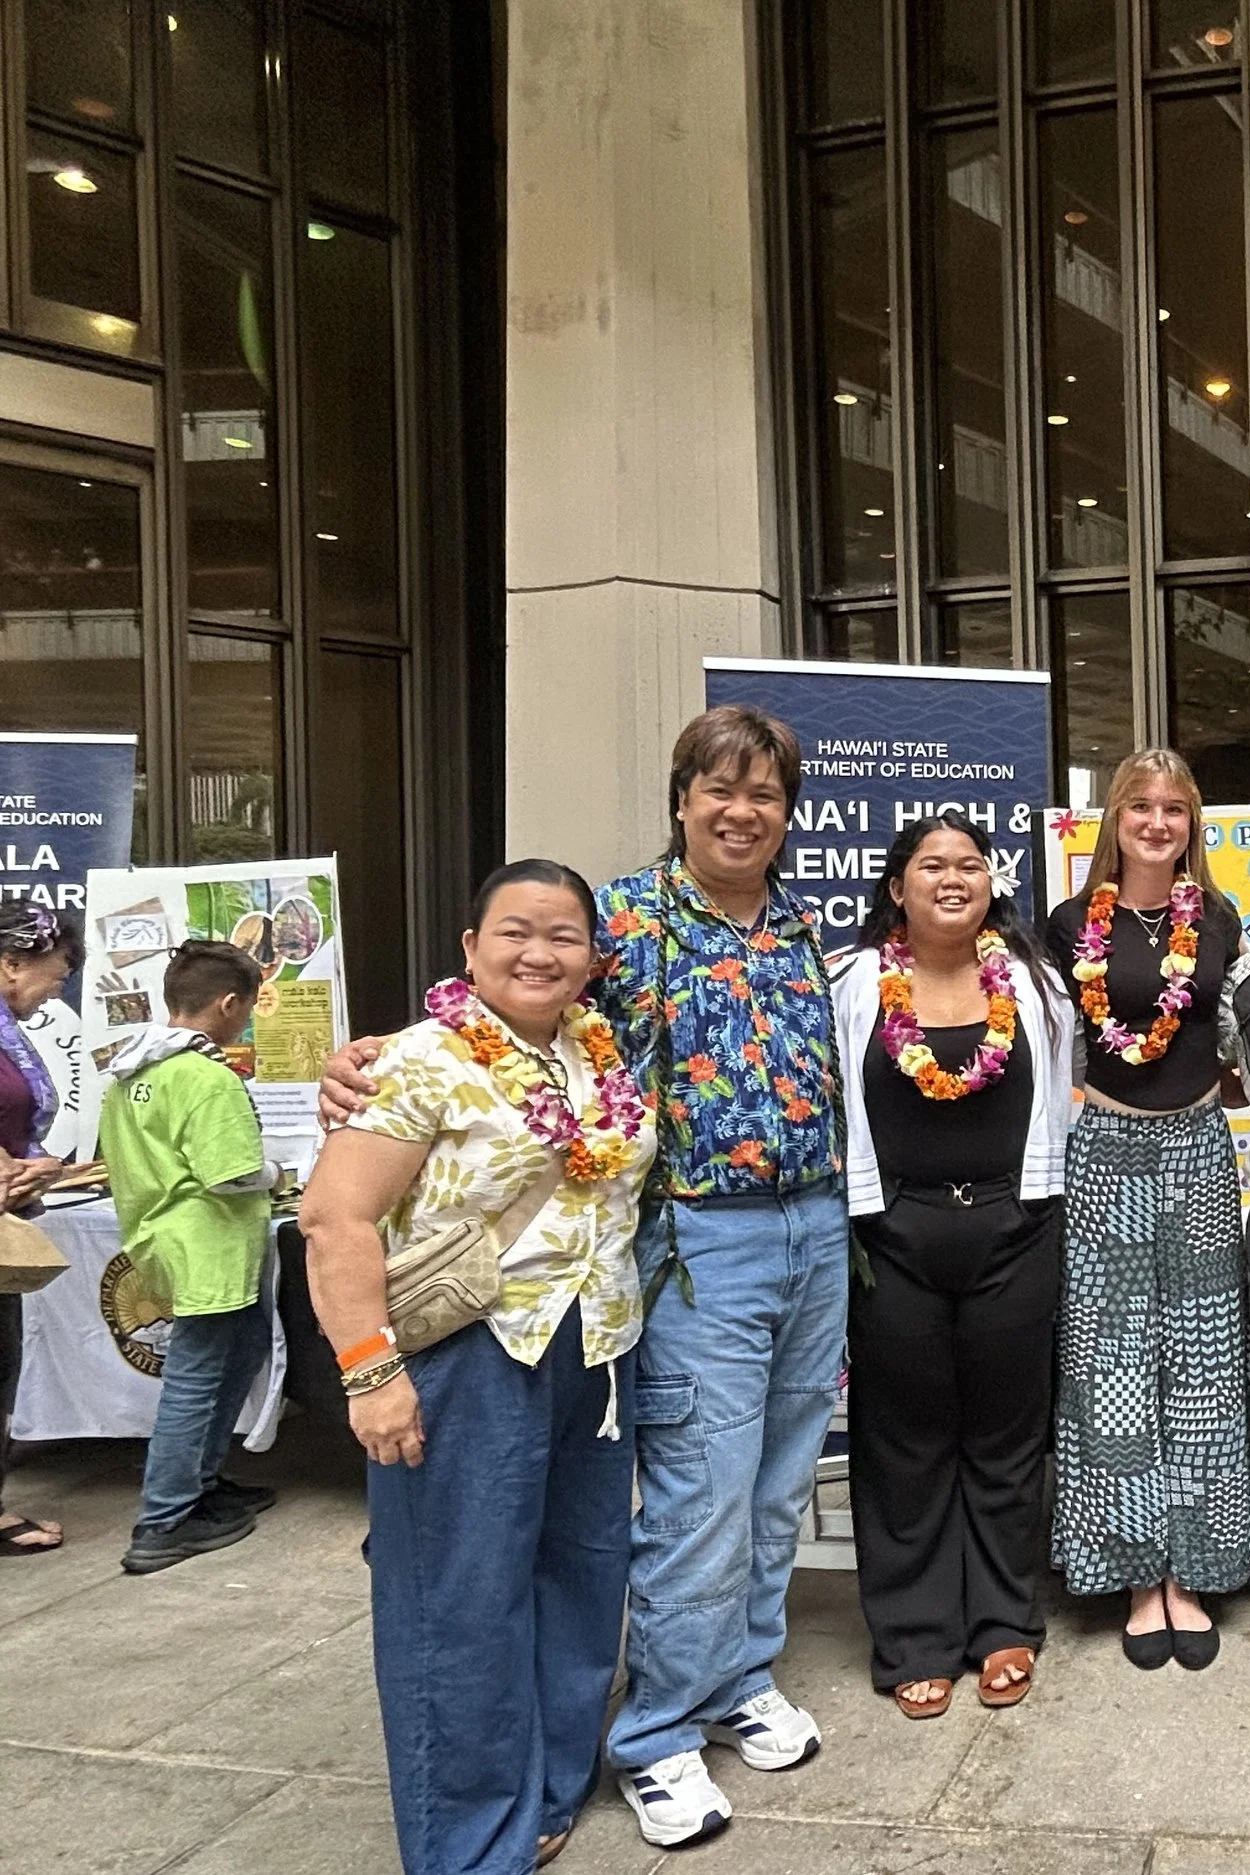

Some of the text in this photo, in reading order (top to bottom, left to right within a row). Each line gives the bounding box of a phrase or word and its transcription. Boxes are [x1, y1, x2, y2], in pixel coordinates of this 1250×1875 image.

[892, 742, 949, 759] STATE
[880, 761, 906, 777] OF
[911, 763, 1014, 780] EDUCATION
[0, 812, 103, 826] EDUCATION
[1008, 803, 1032, 834] &
[0, 844, 61, 871] LA
[0, 883, 87, 910] TAR
